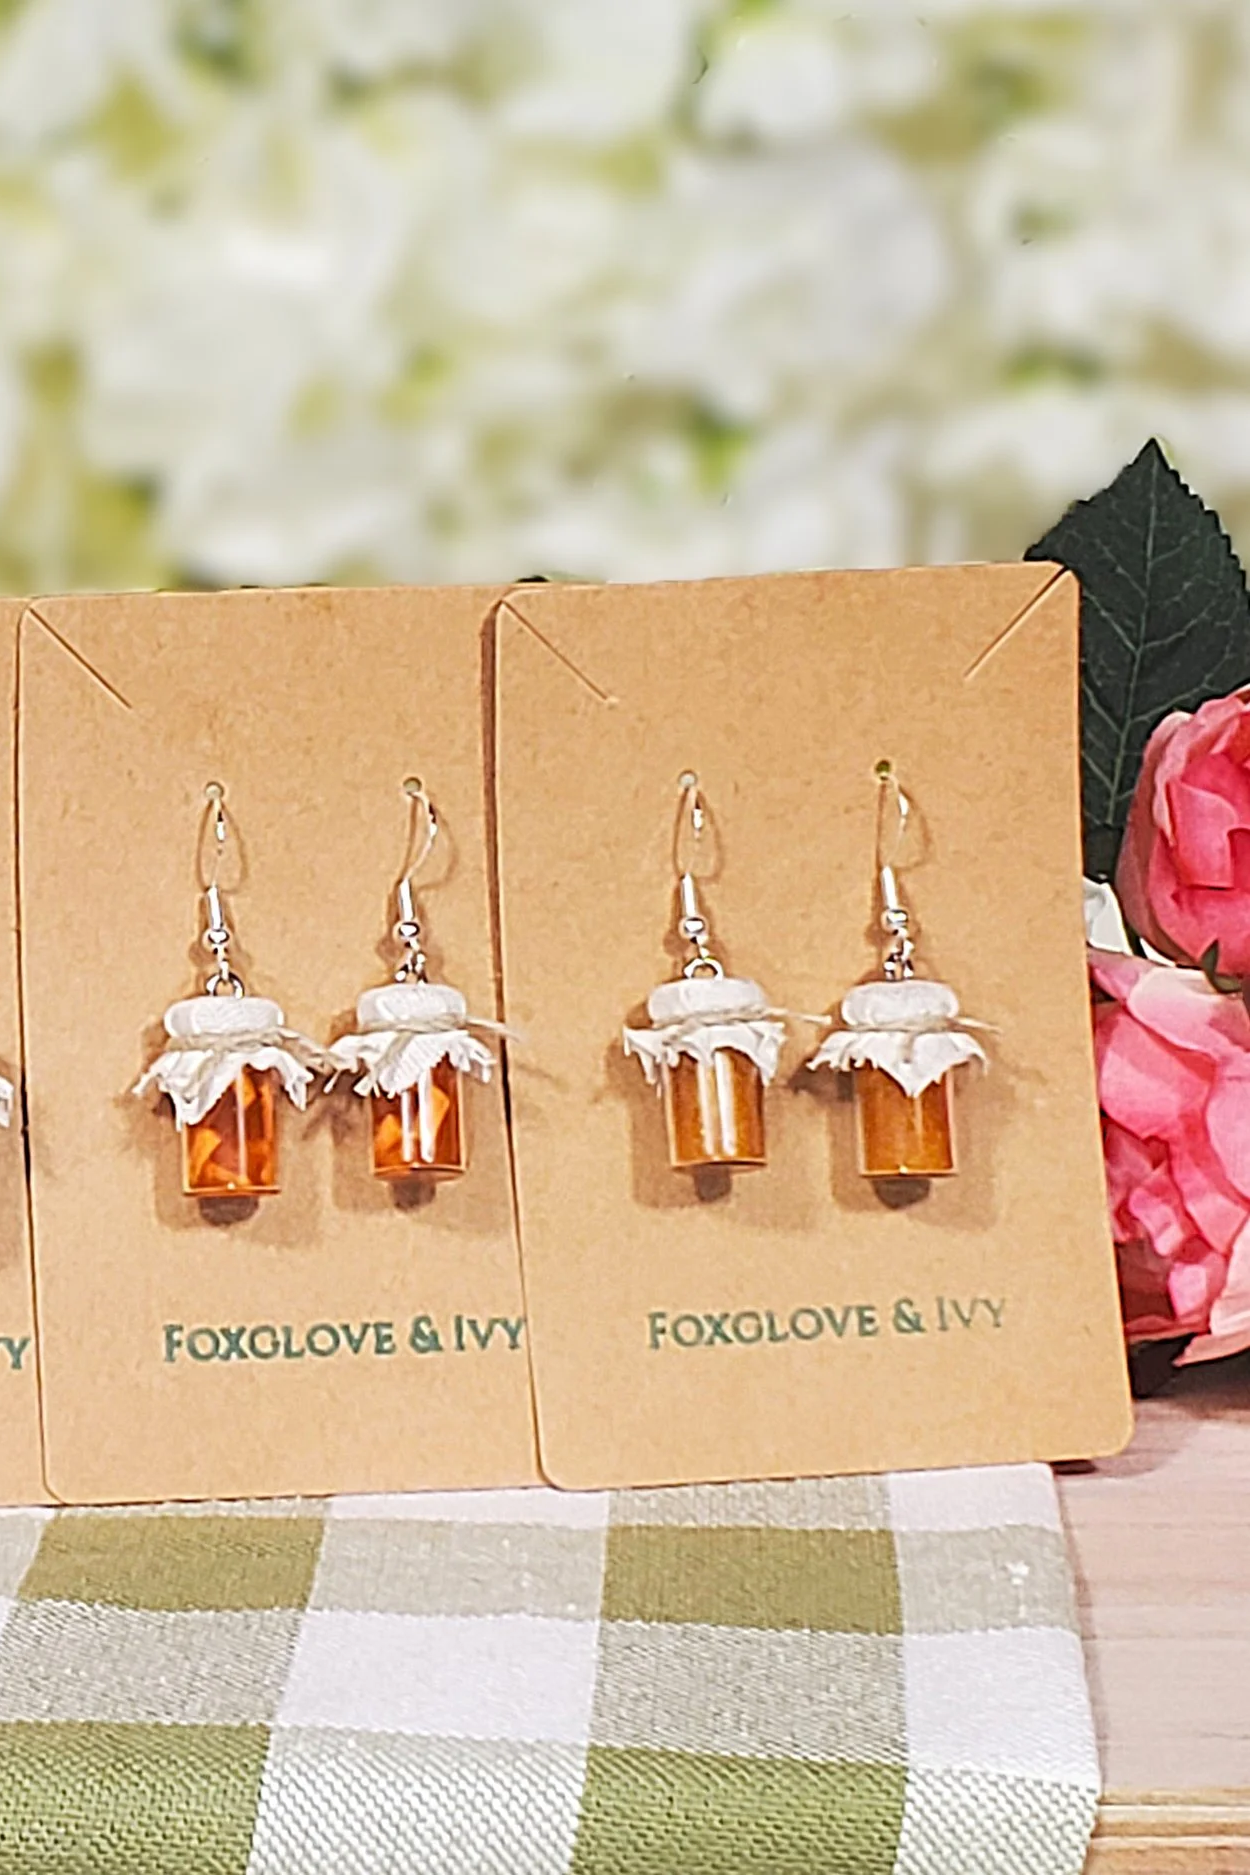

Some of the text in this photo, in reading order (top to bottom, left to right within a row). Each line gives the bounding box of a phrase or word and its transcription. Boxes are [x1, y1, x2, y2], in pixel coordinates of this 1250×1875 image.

[162, 1314, 526, 1362] FOXGLOVE & IVY
[649, 1296, 1006, 1350] FOXGLOVE & IVY
